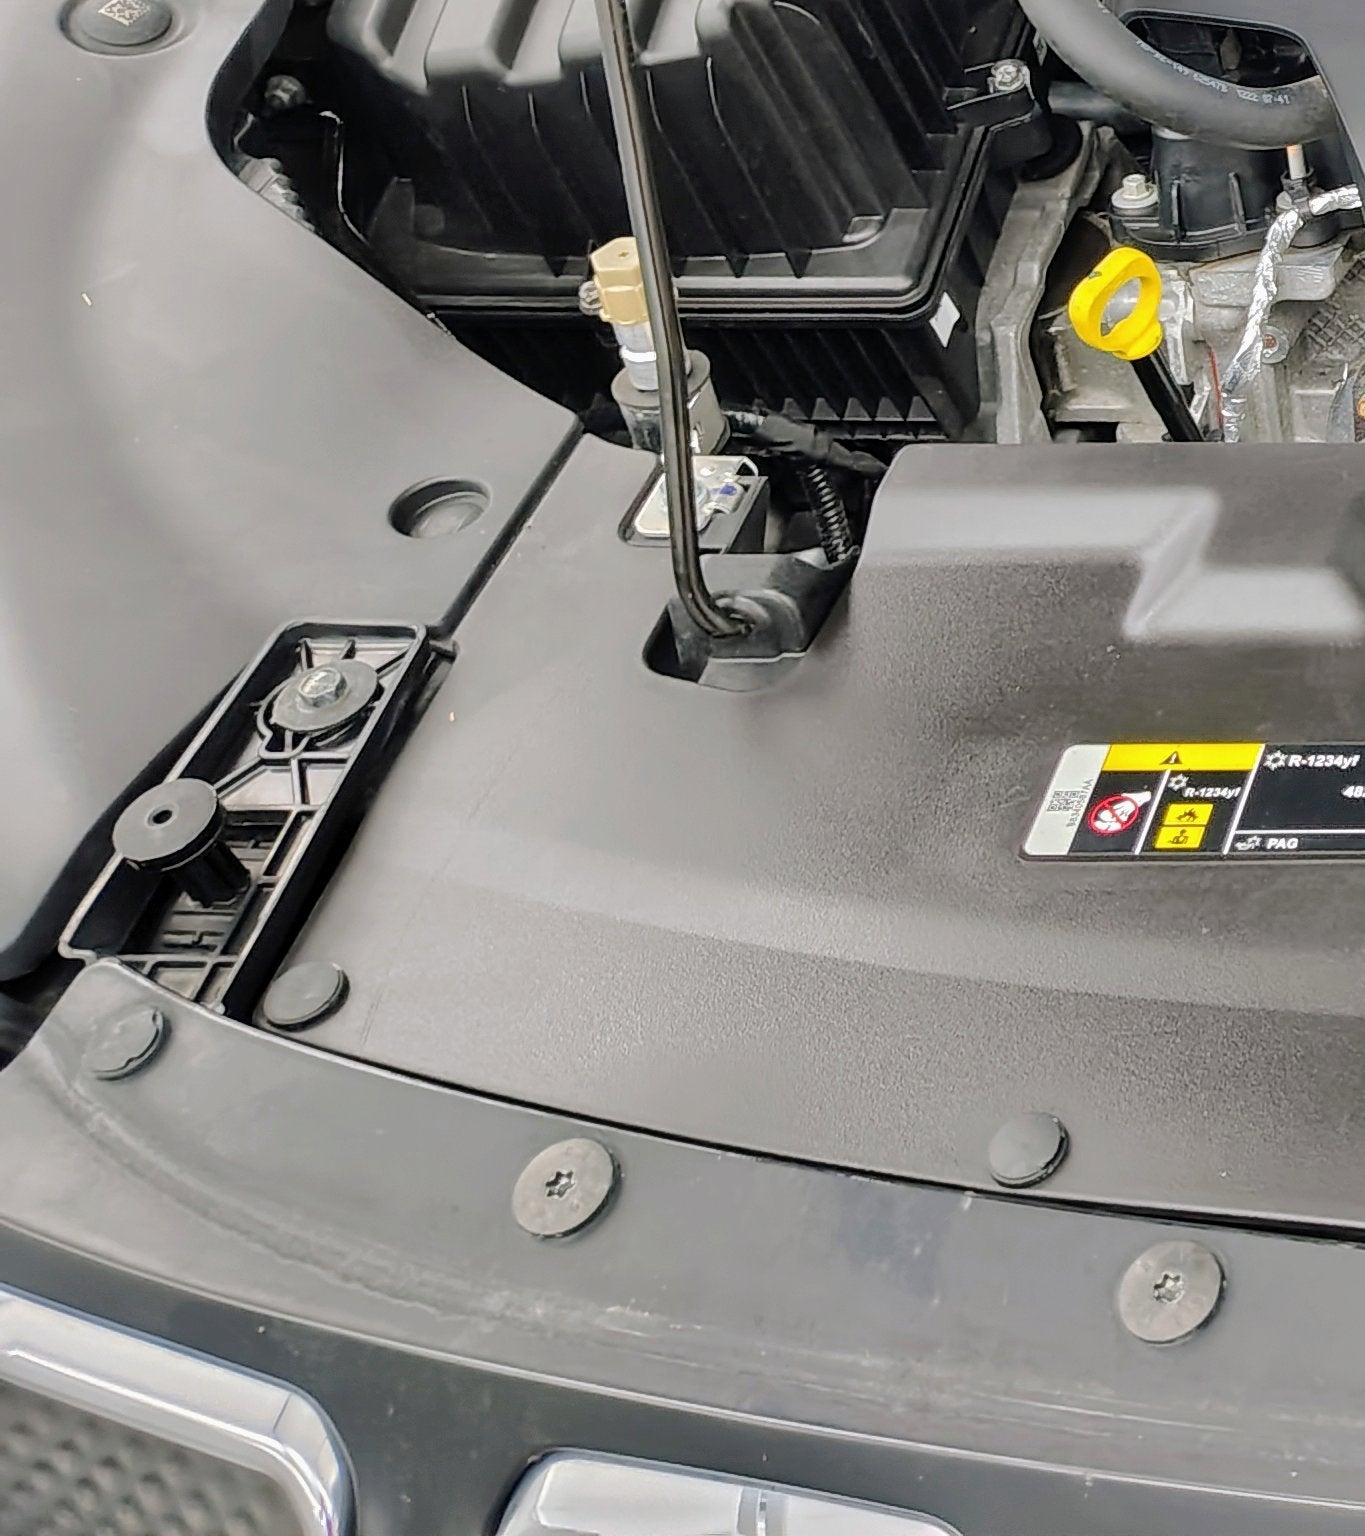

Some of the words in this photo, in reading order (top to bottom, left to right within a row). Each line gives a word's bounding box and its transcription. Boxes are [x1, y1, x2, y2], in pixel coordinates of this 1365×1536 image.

[1287, 754, 1361, 770] R-1234yf
[1183, 786, 1242, 800] R-1234yf
[1266, 837, 1299, 850] PAG
